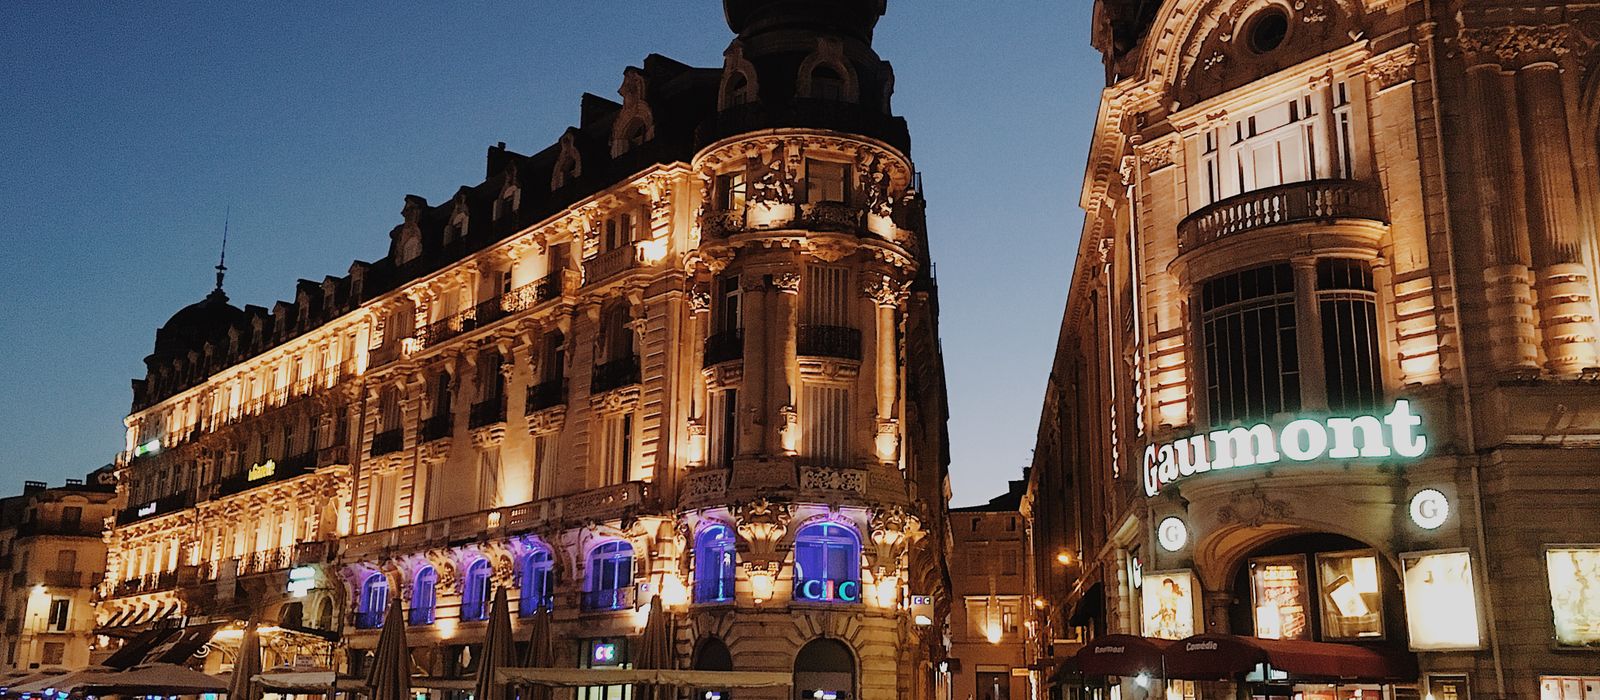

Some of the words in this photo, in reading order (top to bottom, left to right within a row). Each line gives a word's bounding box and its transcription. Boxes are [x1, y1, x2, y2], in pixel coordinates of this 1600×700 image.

[1143, 399, 1426, 497] Gaumont
[1419, 499, 1438, 518] G
[1165, 525, 1179, 543] G
[803, 580, 856, 601] CIC
